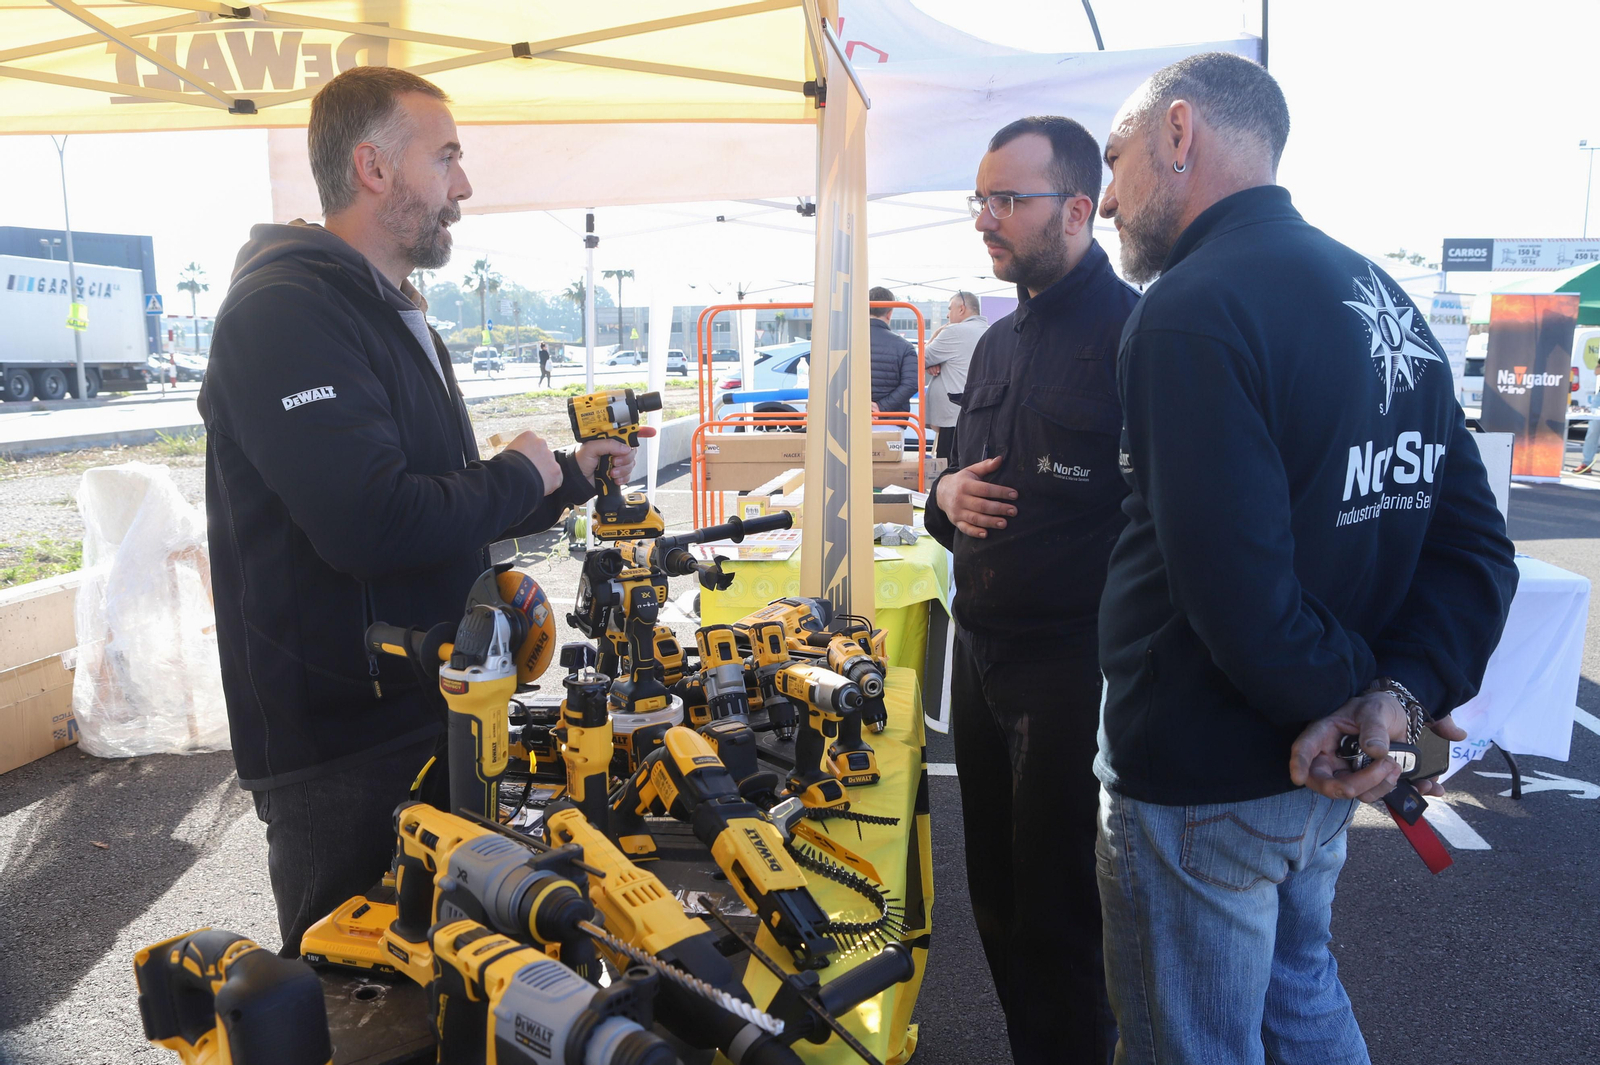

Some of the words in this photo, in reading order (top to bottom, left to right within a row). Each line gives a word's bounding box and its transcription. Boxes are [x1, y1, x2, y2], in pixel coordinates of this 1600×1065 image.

[1448, 248, 1488, 257] CARROS
[1532, 248, 1541, 257] kg
[1590, 252, 1599, 261] kg
[1588, 346, 1599, 354] Na
[1497, 366, 1564, 388] Navigator
[1497, 385, 1526, 394] V-line
[282, 386, 335, 411] DEWALT
[1053, 462, 1091, 477] NorSur
[1336, 502, 1381, 527] Industria
[526, 631, 549, 672] DEWALT
[612, 736, 628, 744] ALT
[848, 775, 872, 783] DEWALT
[745, 828, 783, 872] DEWALT
[307, 953, 320, 962] 18V
[515, 1013, 554, 1044] DEWALT
